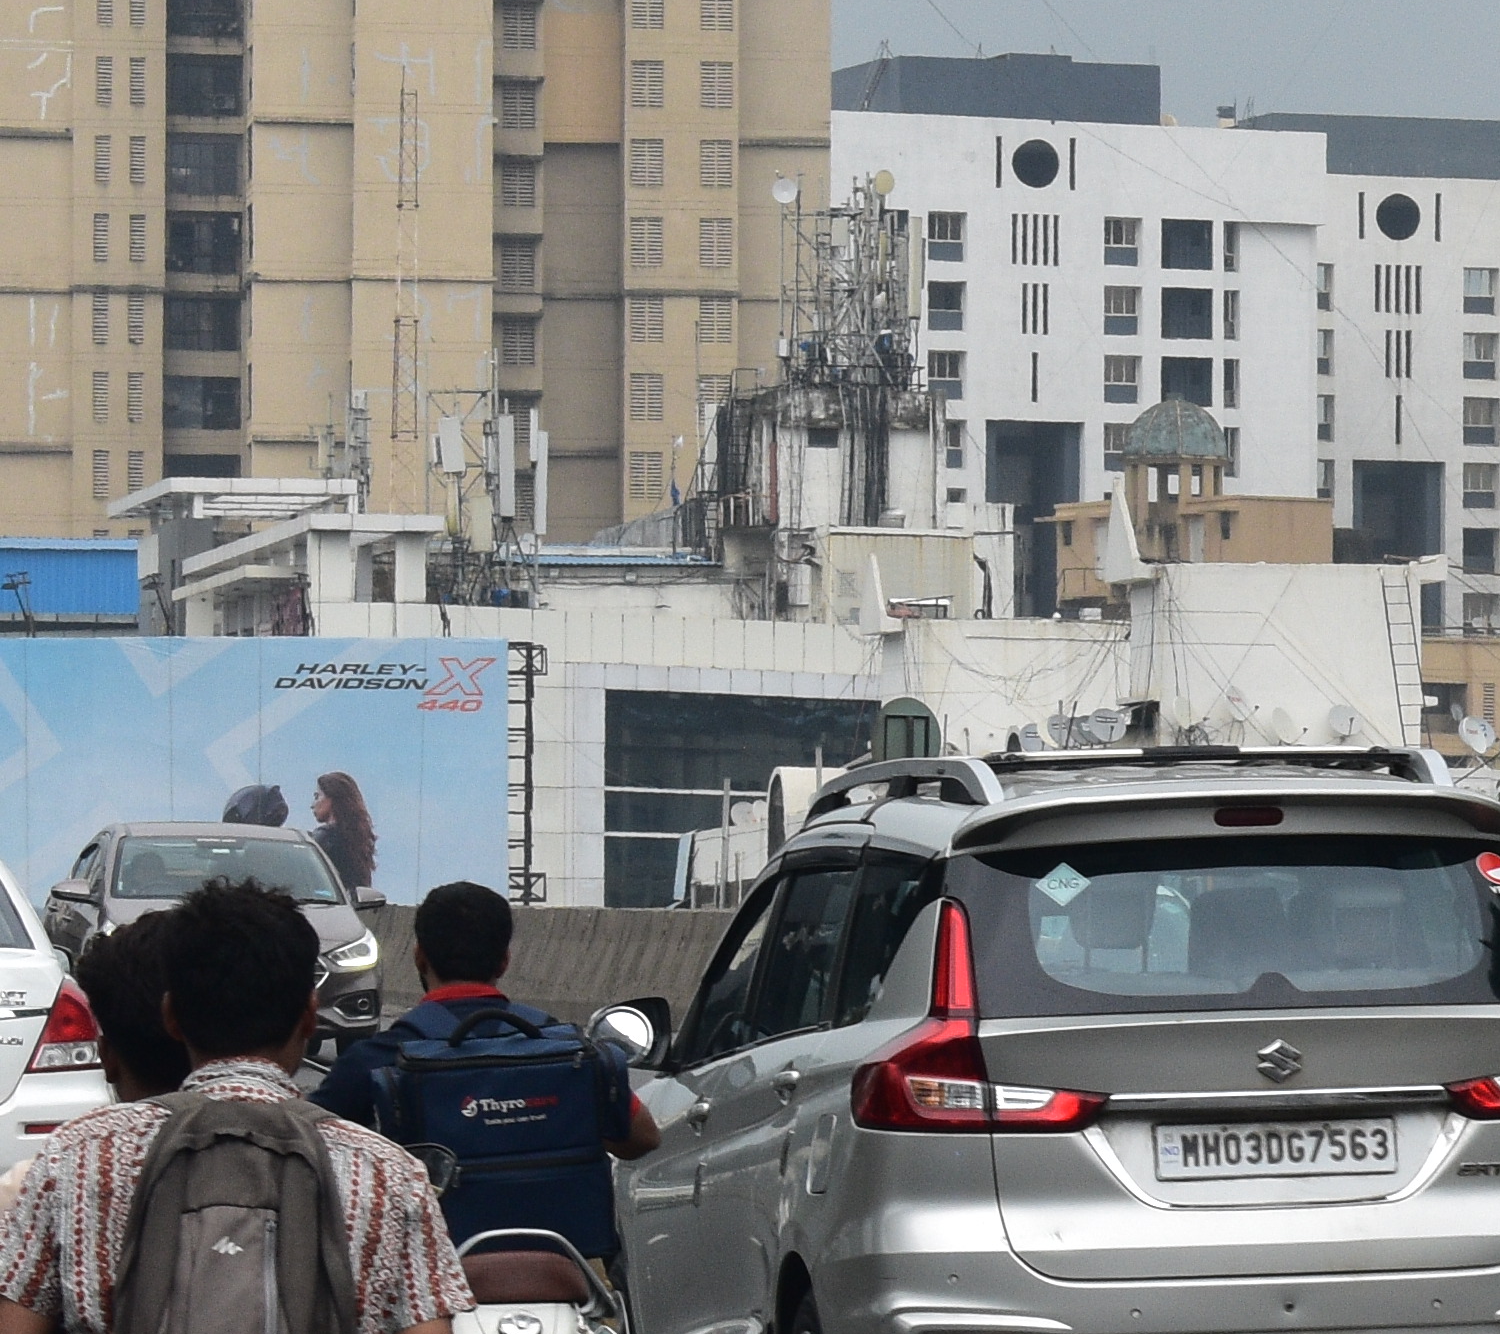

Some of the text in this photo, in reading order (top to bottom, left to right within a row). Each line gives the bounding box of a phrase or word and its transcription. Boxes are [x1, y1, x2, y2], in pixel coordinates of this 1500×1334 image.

[295, 663, 427, 675] HARLEY-
[423, 657, 497, 696] X
[274, 677, 428, 690] DAVIDSON
[416, 699, 483, 712] 440
[1047, 877, 1080, 890] CNG
[1181, 1129, 1389, 1167] MH03DG7563
